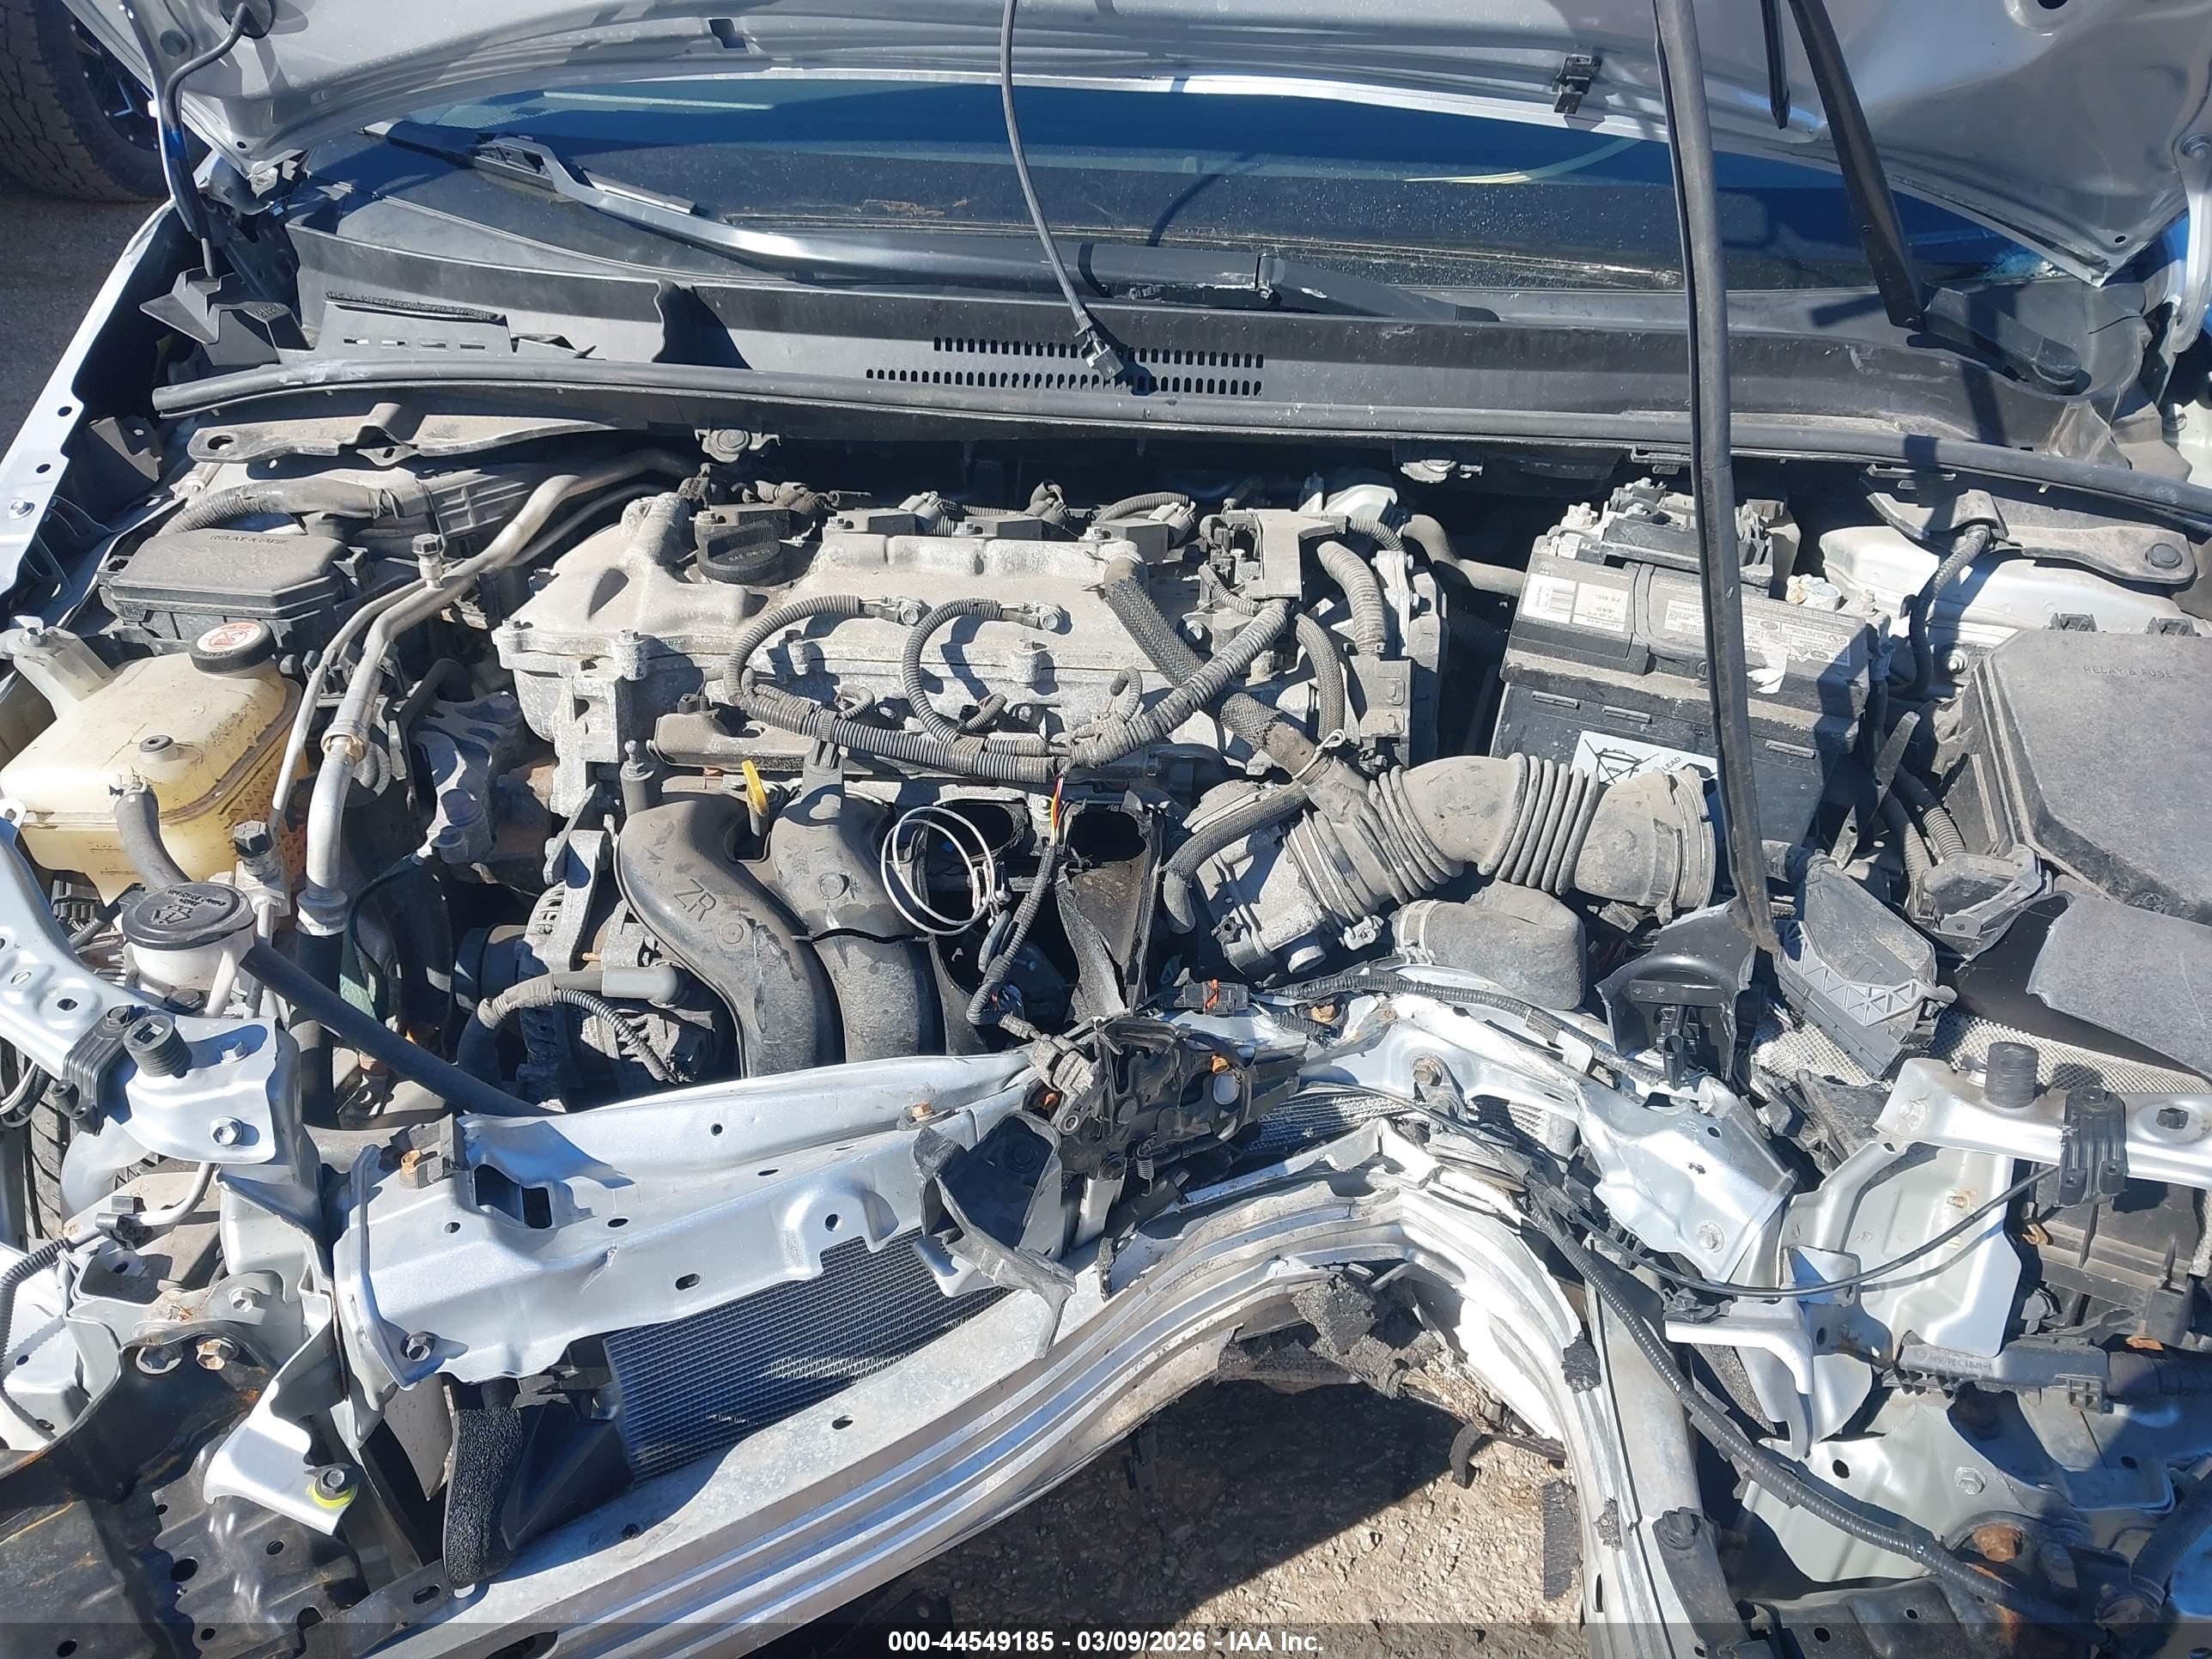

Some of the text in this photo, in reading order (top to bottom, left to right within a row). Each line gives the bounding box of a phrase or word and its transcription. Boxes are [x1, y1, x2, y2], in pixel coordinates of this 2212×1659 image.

[2083, 665, 2123, 674] RELAY
[1662, 756, 1682, 772] LEAD
[672, 878, 717, 923] ZR
